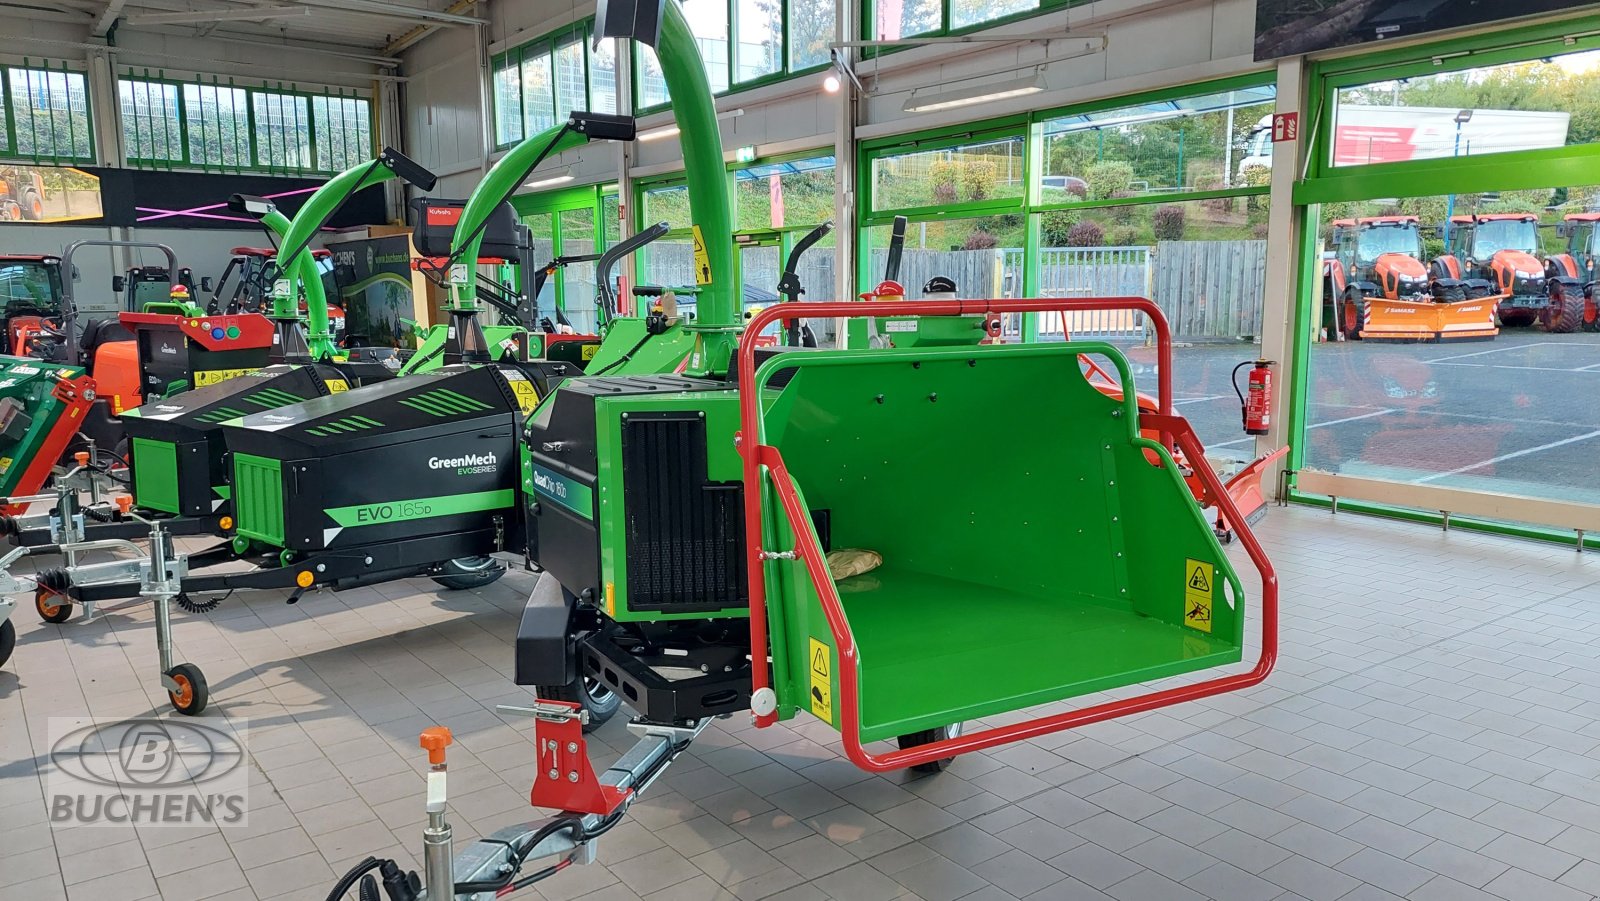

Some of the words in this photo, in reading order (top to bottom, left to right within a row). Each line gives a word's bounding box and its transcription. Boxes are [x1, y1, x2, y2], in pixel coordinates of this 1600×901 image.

[335, 251, 355, 266] CHEN'S
[428, 451, 497, 470] GreenMech
[457, 465, 497, 475] EVOSERIES
[533, 470, 555, 494] QuadChip
[357, 505, 393, 522] EVO
[398, 502, 432, 517] 165D
